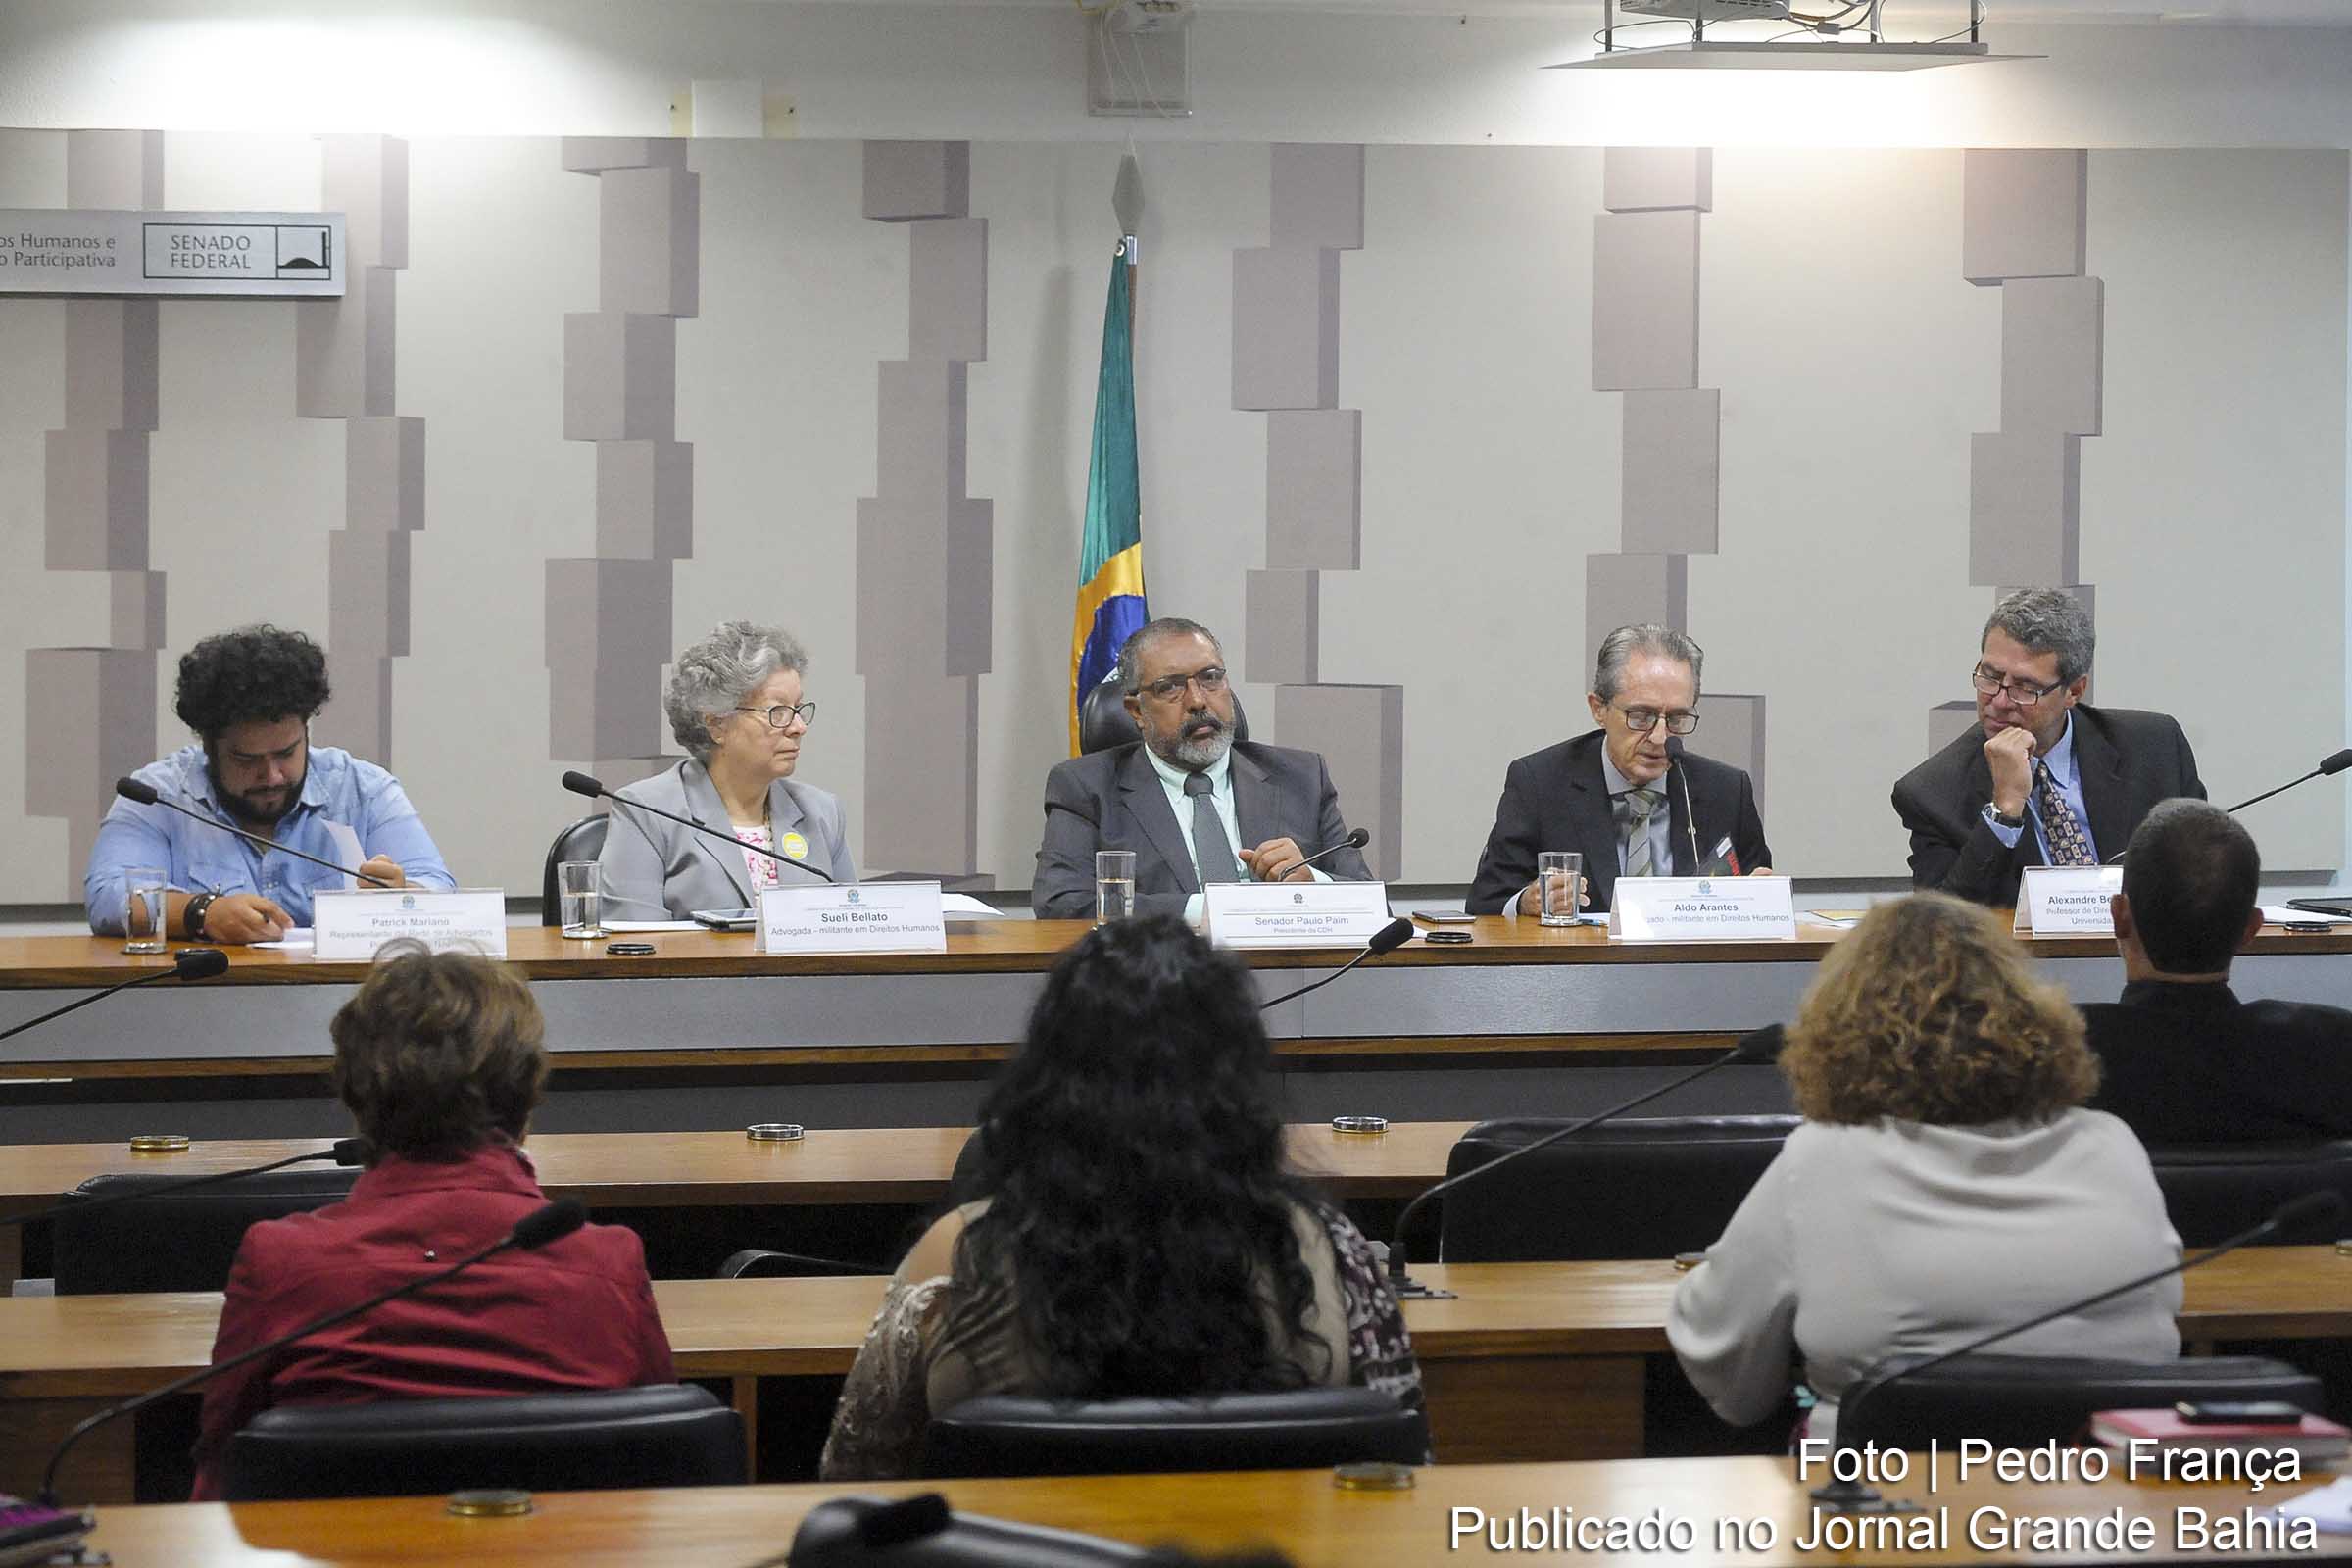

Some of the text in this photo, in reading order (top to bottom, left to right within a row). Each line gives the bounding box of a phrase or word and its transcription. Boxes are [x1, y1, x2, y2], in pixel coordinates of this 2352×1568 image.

[21, 233, 100, 248] Humanos
[106, 237, 116, 249] e
[170, 235, 251, 251] SENADO
[14, 251, 116, 270] Participativa
[170, 253, 251, 269] FEDERAL
[2048, 895, 2097, 906] Alexandre
[1674, 903, 1739, 912] Aldo Arantes
[2046, 906, 2081, 916] Professor
[371, 917, 450, 928] Patrick Mariano
[820, 912, 888, 923] Sueli Bellato
[1254, 916, 1349, 926] Senador Paulo Paim
[1721, 913, 1751, 923] Direitos
[1752, 914, 1790, 923] Humanos
[771, 926, 812, 937] Advogada
[818, 925, 853, 935] militante
[869, 925, 901, 934] Direitos
[902, 924, 940, 933] Humanos
